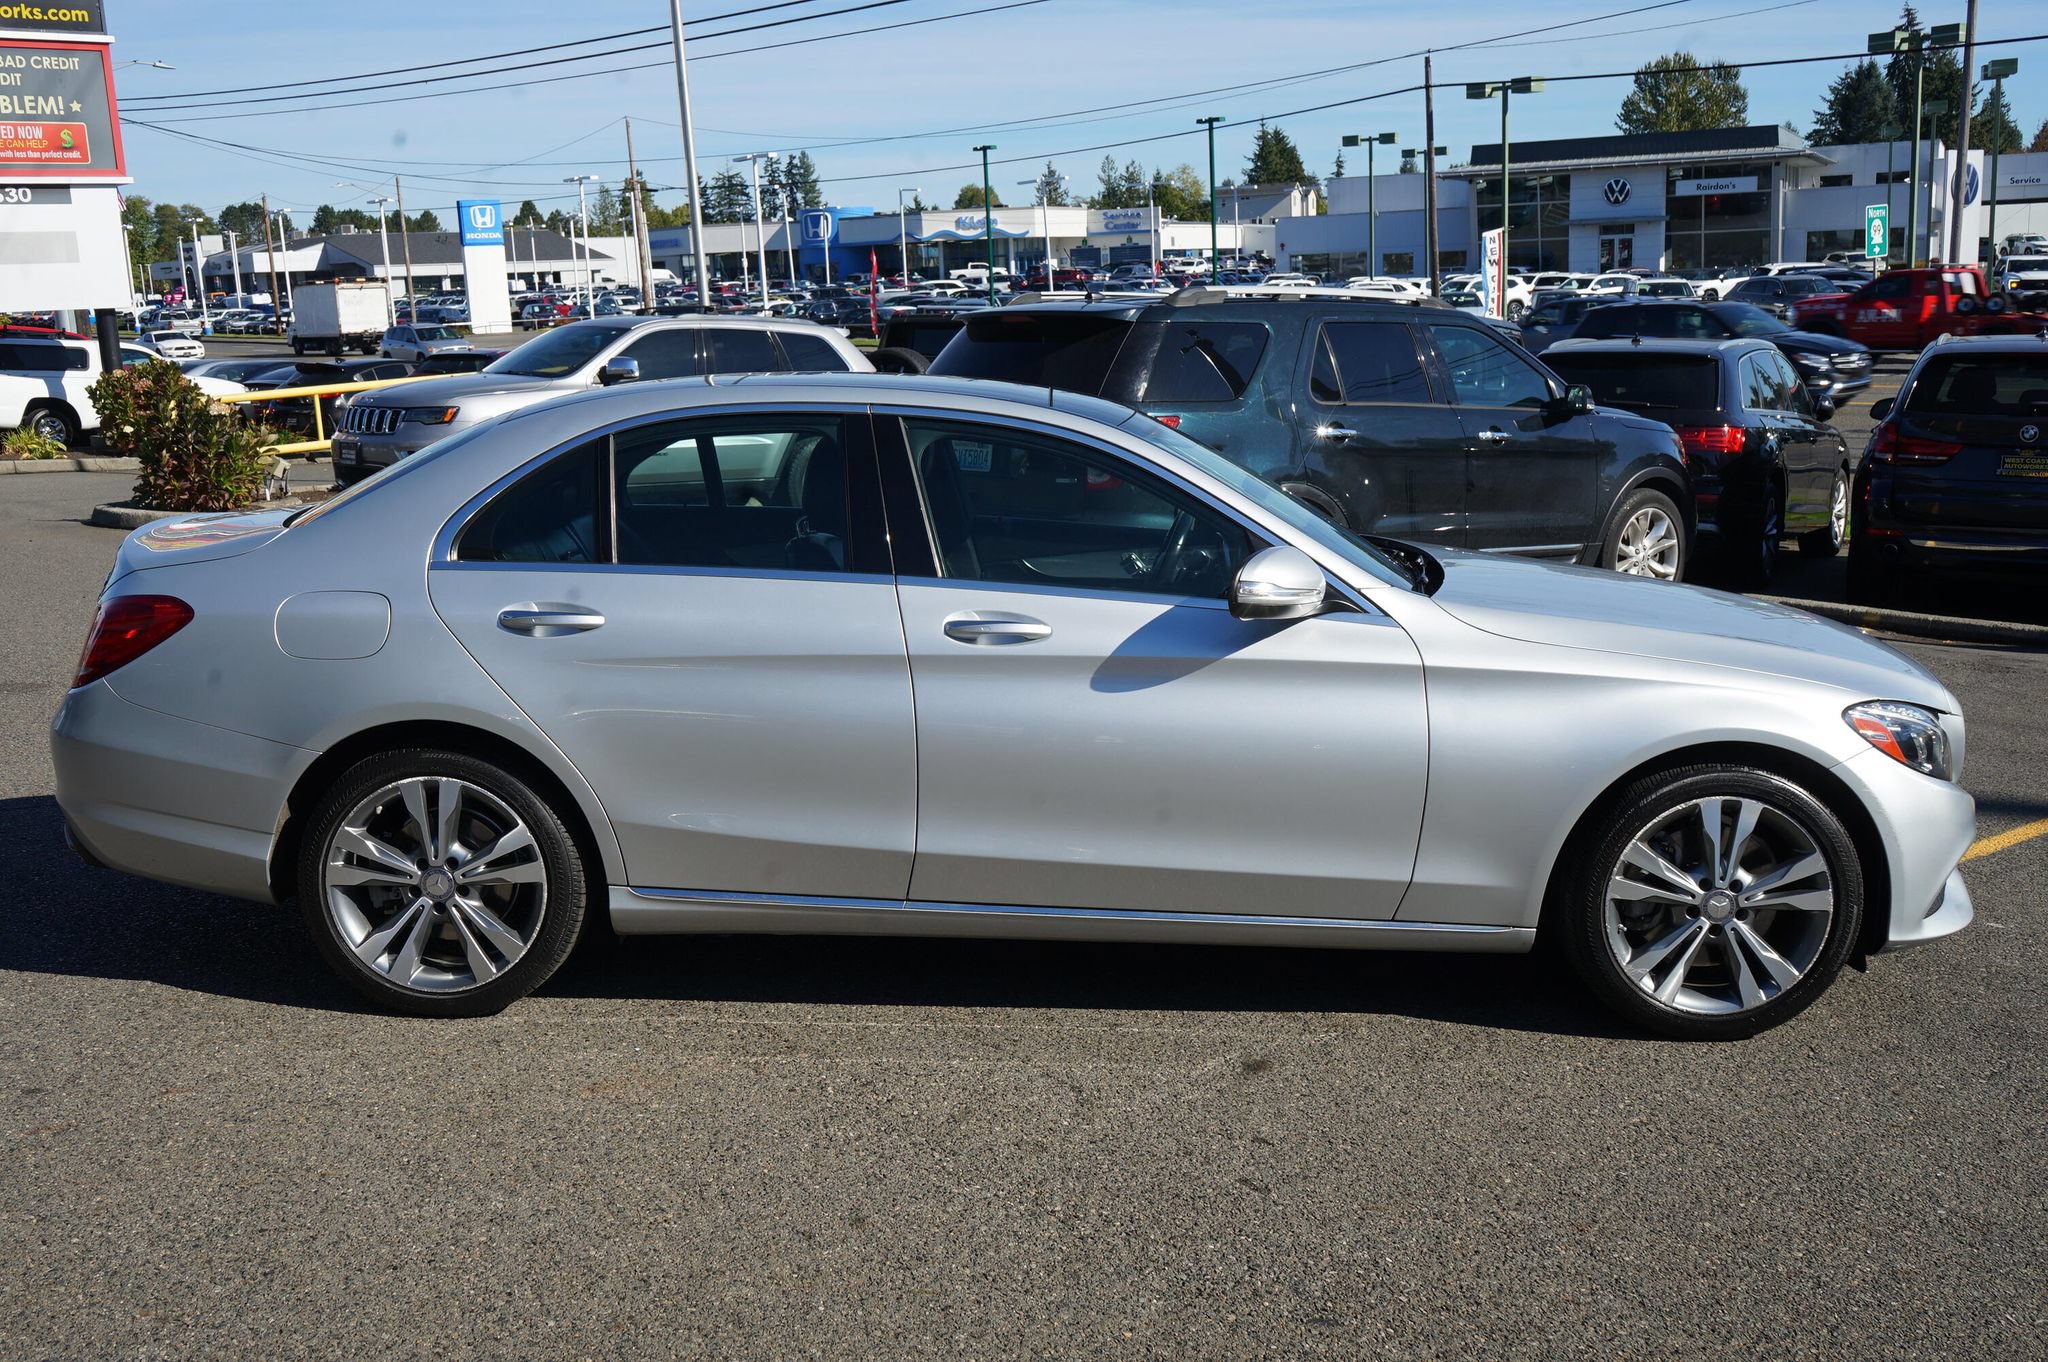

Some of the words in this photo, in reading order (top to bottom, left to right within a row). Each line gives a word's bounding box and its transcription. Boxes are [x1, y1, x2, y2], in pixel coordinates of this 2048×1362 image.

[0, 3, 89, 22] orks.com
[30, 56, 80, 70] CREDIT
[0, 73, 21, 86] DIT
[0, 95, 65, 115] BLEM!
[0, 125, 14, 138] ED
[17, 126, 43, 139] NOW
[6, 140, 25, 148] CAN
[26, 140, 49, 148] HELP
[0, 150, 14, 158] with
[14, 150, 27, 158] less
[27, 150, 41, 158] than
[41, 151, 63, 160] perfect
[1696, 181, 1737, 192] Rairdon's
[2010, 176, 2041, 185] Service
[955, 215, 998, 231] Klen
[1872, 224, 1882, 236] 99
[1488, 274, 1497, 316] CS
